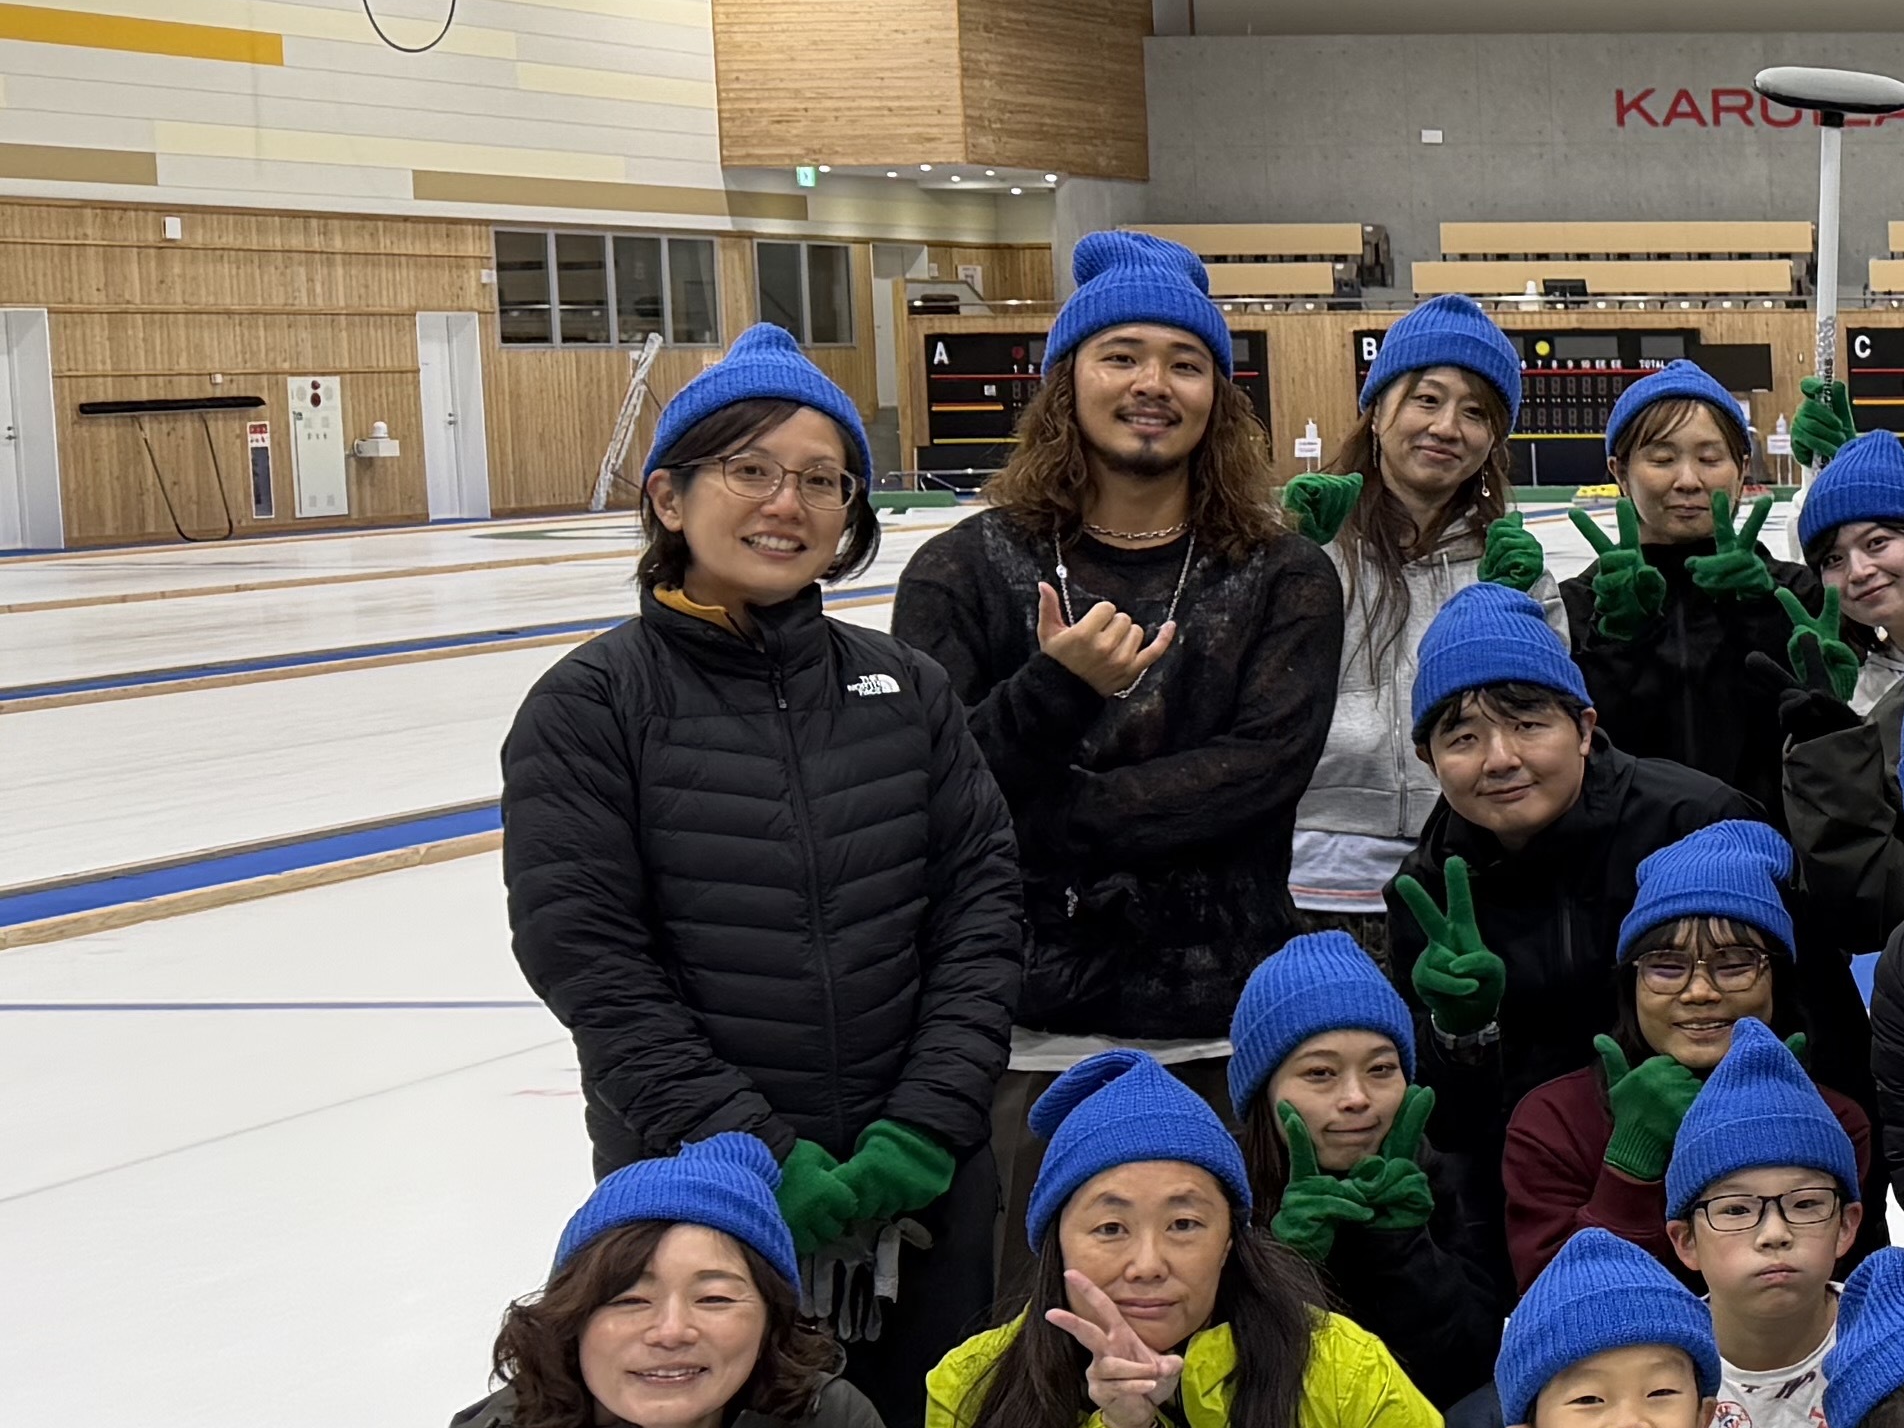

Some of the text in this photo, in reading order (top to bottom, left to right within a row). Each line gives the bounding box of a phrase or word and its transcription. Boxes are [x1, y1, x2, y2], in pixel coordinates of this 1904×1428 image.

[933, 341, 949, 365] A
[1362, 337, 1378, 361] B
[1854, 335, 1871, 359] C
